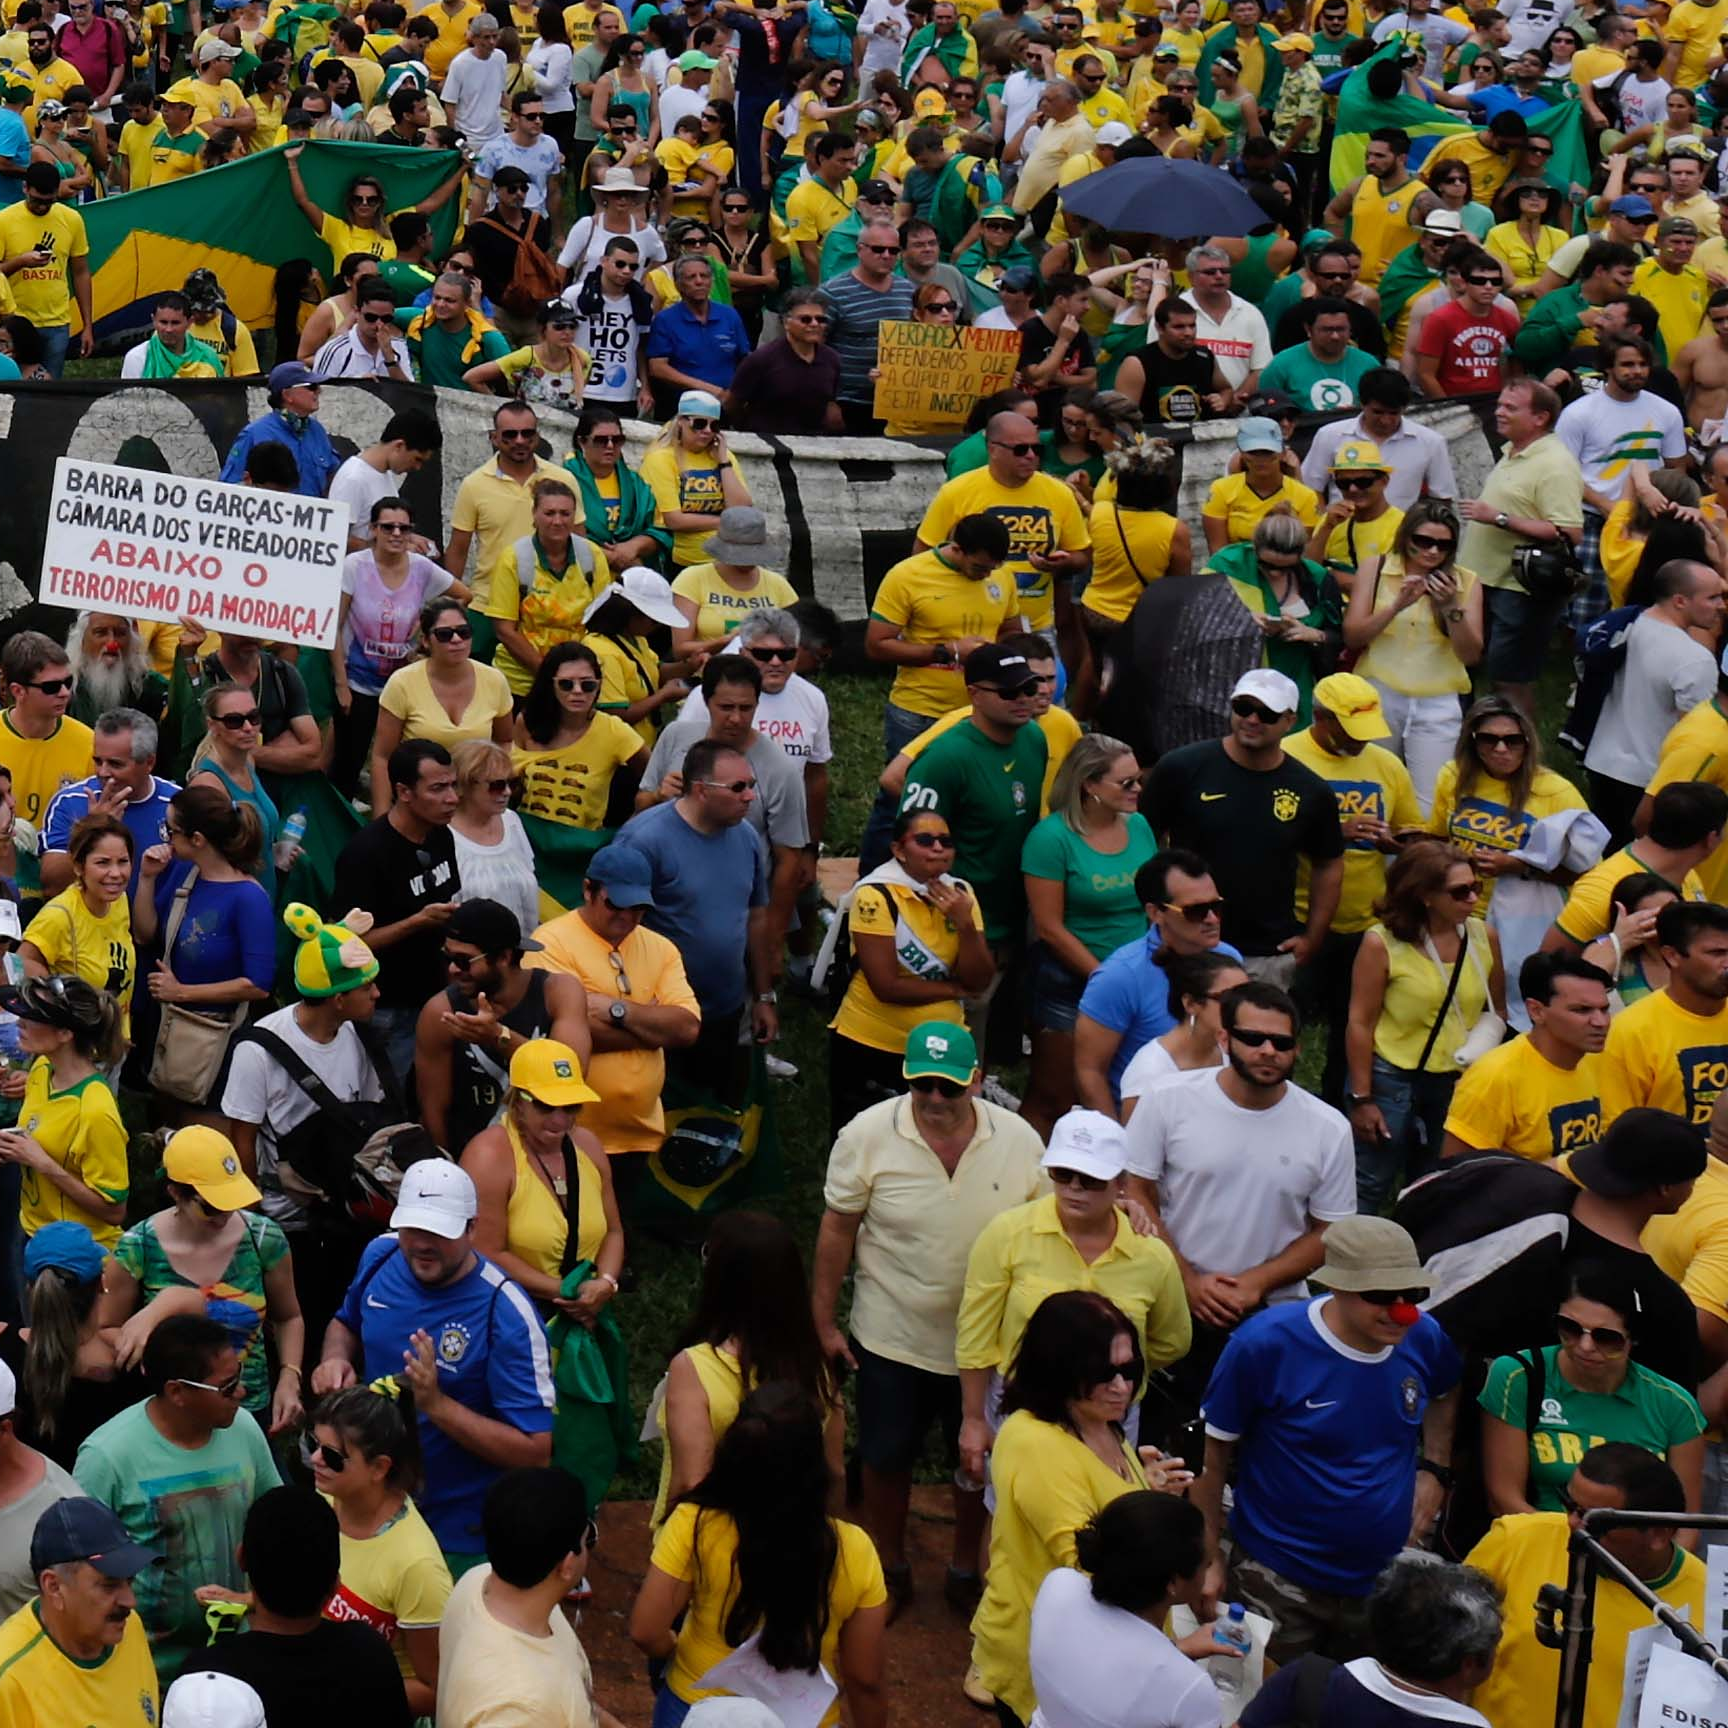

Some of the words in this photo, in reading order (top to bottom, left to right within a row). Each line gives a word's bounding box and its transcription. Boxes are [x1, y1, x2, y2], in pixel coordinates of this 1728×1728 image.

[589, 311, 634, 329] HEY
[590, 328, 630, 351] HO
[881, 327, 951, 349] VERDADE
[951, 328, 963, 350] X
[963, 330, 1023, 354] MENTIRA
[589, 348, 627, 364] LETS
[879, 347, 967, 371] DEFENDEMOS
[980, 355, 1011, 375] QUE
[955, 371, 975, 386] DO
[980, 376, 1004, 393] PT
[65, 467, 143, 503] BARRA
[153, 481, 186, 508] DO
[194, 489, 334, 532] GARÇAS-MT
[55, 494, 147, 537] CÂMARA
[152, 515, 190, 543] DOS
[198, 521, 339, 567] VEREADORES
[90, 538, 223, 581] ABAIXO
[243, 563, 269, 588] O
[48, 565, 180, 613] TERRORISMO
[186, 590, 214, 620] DA
[219, 593, 335, 641] MORDAÇA!
[708, 591, 776, 609] BRASIL
[758, 720, 803, 737] FORA
[902, 782, 939, 814] 20
[1454, 808, 1528, 843] FORA
